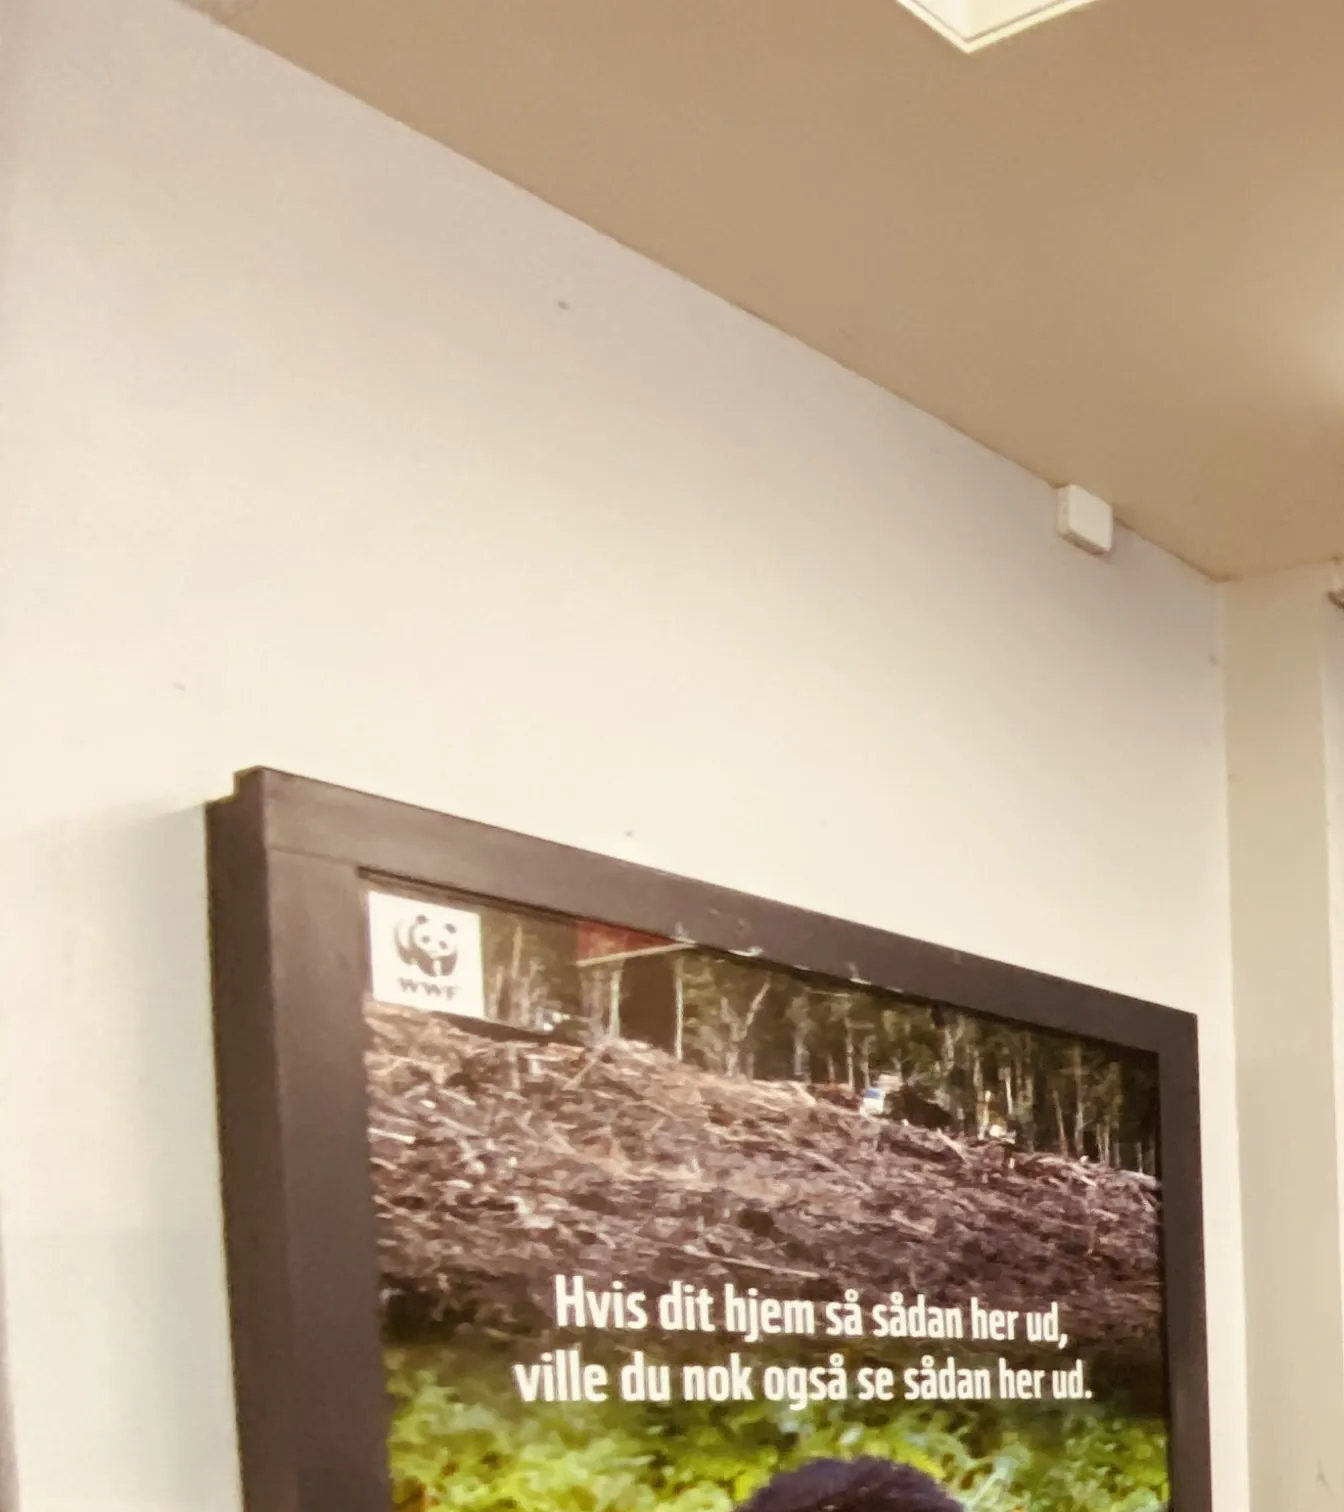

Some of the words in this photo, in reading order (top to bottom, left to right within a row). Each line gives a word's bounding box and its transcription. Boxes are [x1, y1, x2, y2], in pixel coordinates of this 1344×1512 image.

[398, 977, 459, 1000] WWF
[554, 1275, 647, 1331] Hvis
[660, 1280, 715, 1332] dit
[725, 1284, 815, 1342] hjem
[825, 1289, 863, 1336] så
[872, 1288, 964, 1339] sådan
[970, 1297, 1018, 1342] her
[1027, 1302, 1068, 1350] ud,
[514, 1350, 607, 1402] ville
[621, 1351, 670, 1401] du
[684, 1353, 752, 1401] nok
[764, 1354, 847, 1411] også
[858, 1367, 893, 1400] se
[904, 1356, 991, 1400] sådan
[999, 1358, 1045, 1399] her
[1052, 1359, 1093, 1399] ud.
